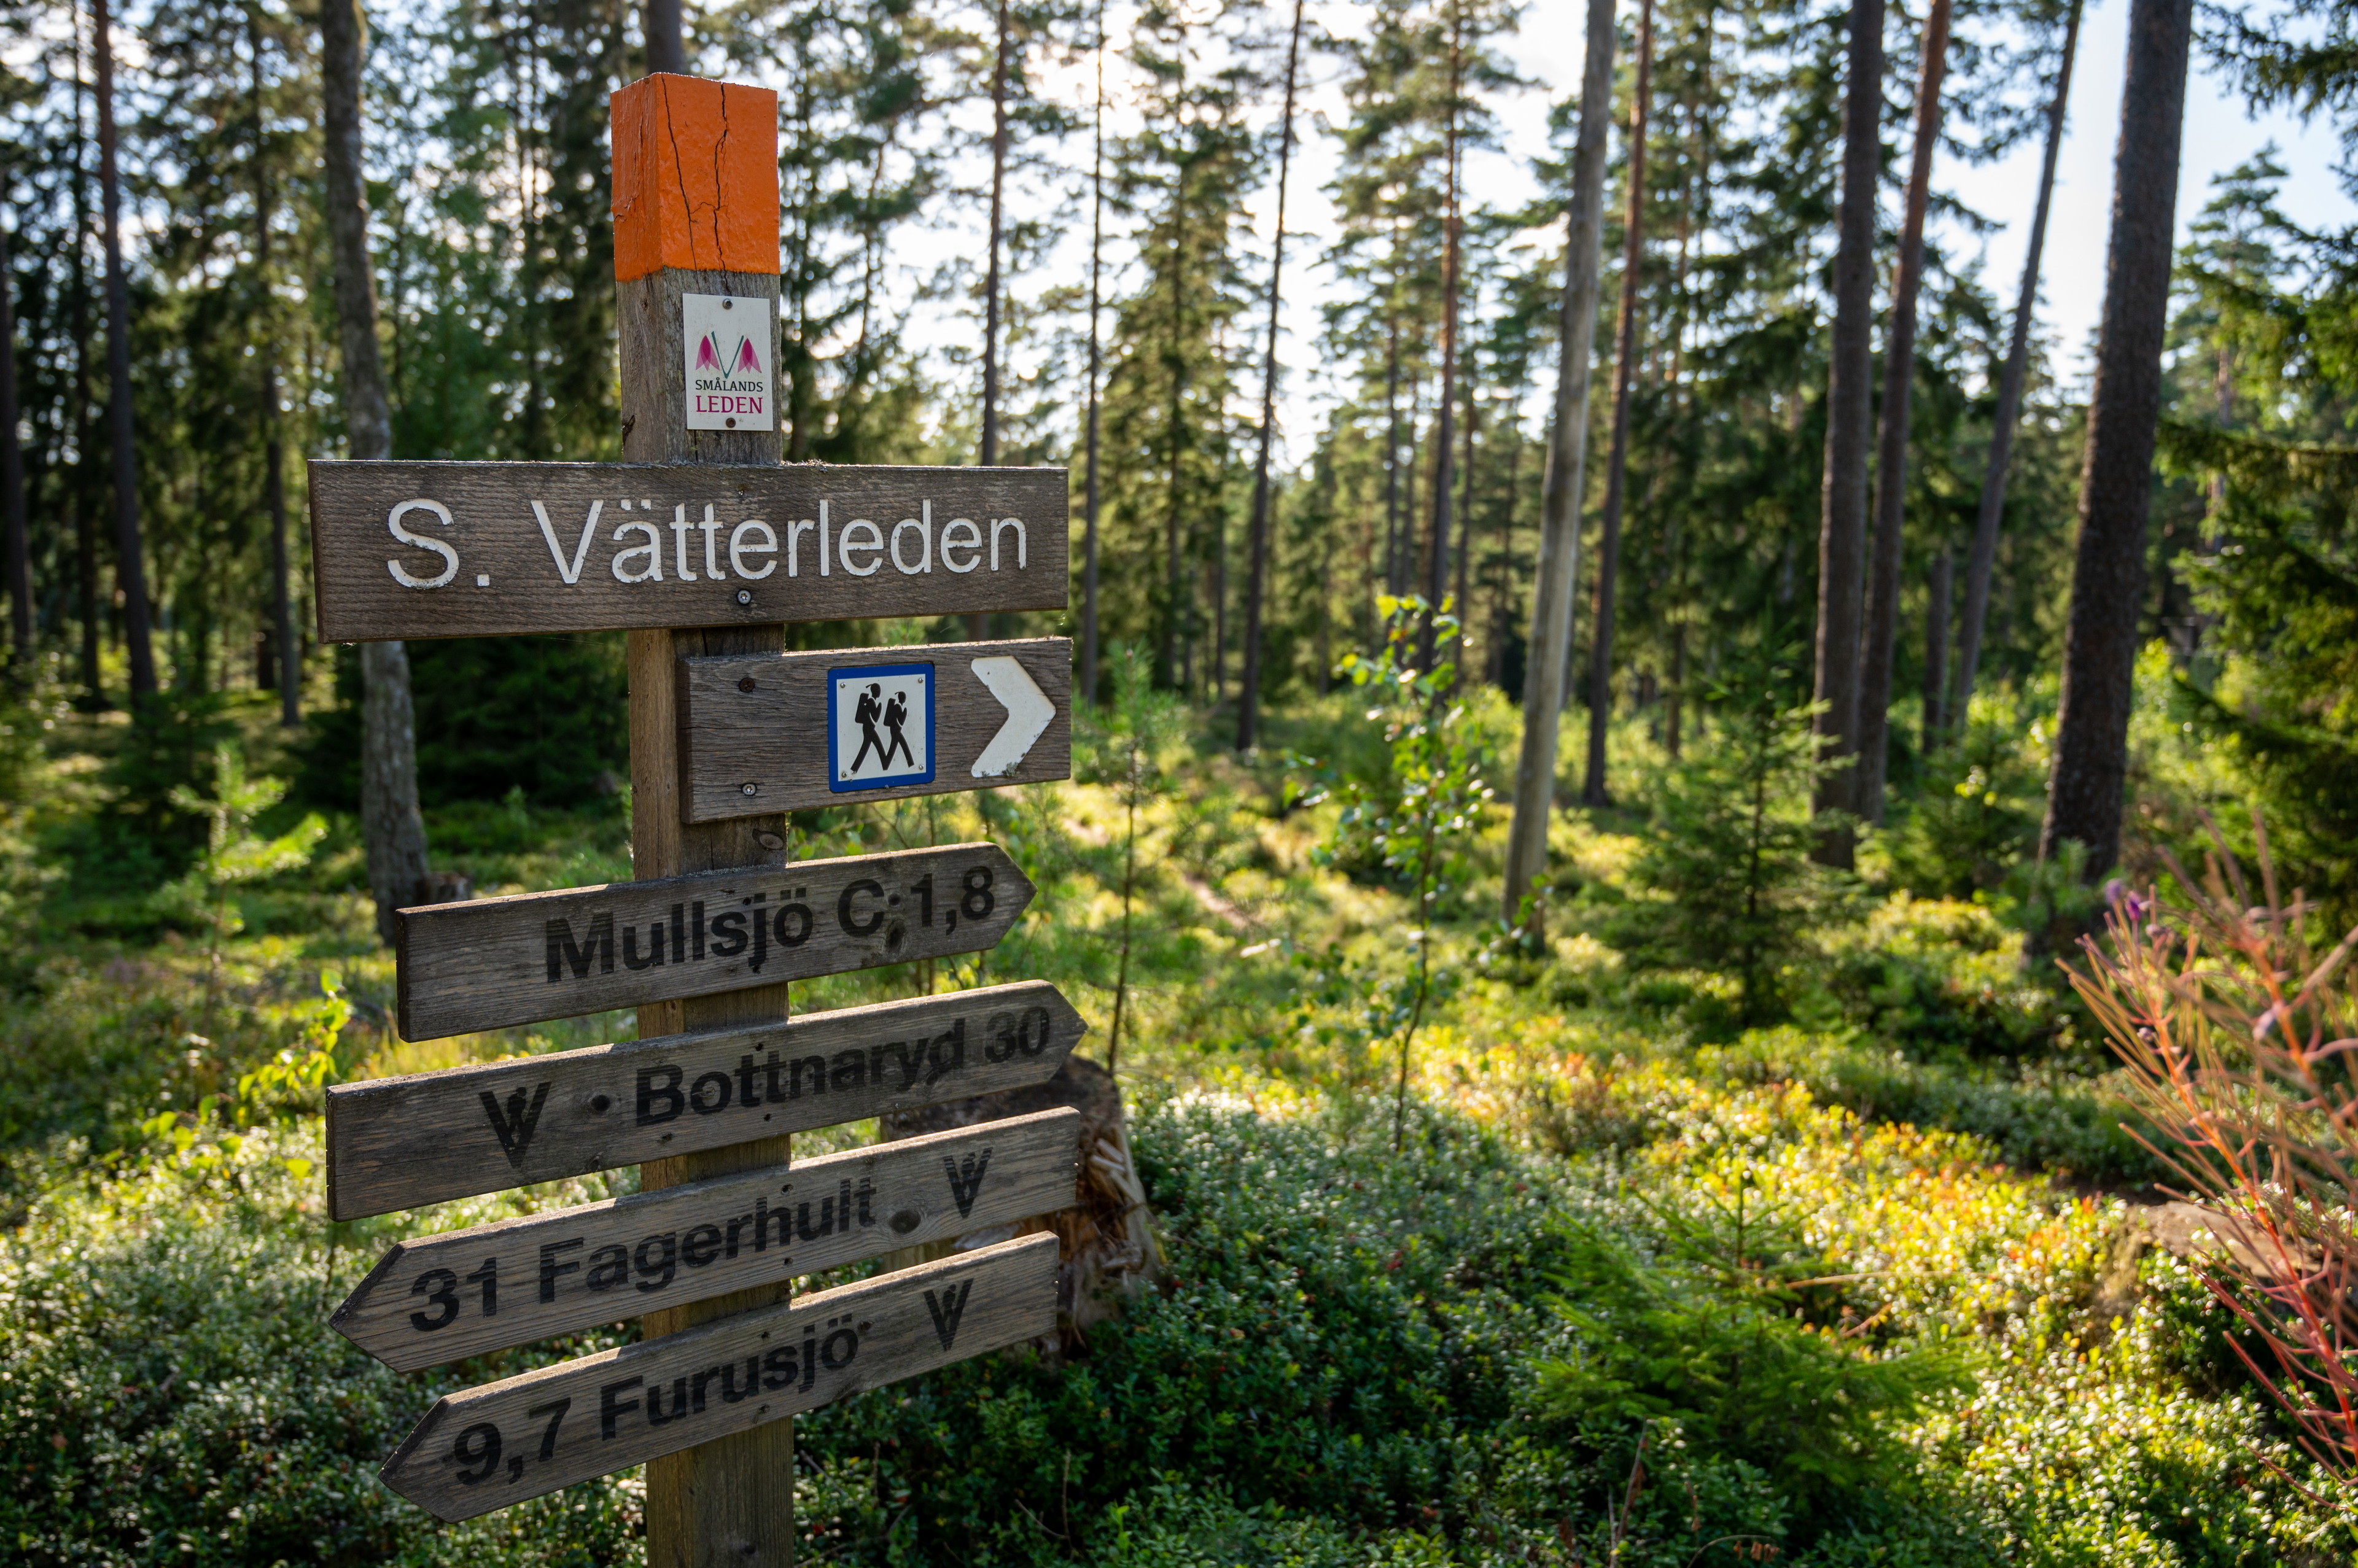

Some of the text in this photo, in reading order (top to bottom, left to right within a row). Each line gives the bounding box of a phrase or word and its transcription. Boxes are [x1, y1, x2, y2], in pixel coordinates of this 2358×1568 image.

[695, 377, 763, 392] SMÅLANDS
[696, 395, 763, 414] LEDEN
[387, 498, 1027, 590] S. Vätterleden
[546, 887, 814, 983] Mullsjö
[910, 866, 995, 936] 1,8
[636, 1018, 966, 1127] Bottnaryd
[984, 1006, 1050, 1063] 30
[410, 1256, 497, 1332] 31
[540, 1176, 877, 1303] Fagerhult
[454, 1397, 572, 1486] 9,7
[601, 1313, 859, 1442] Furusjö
